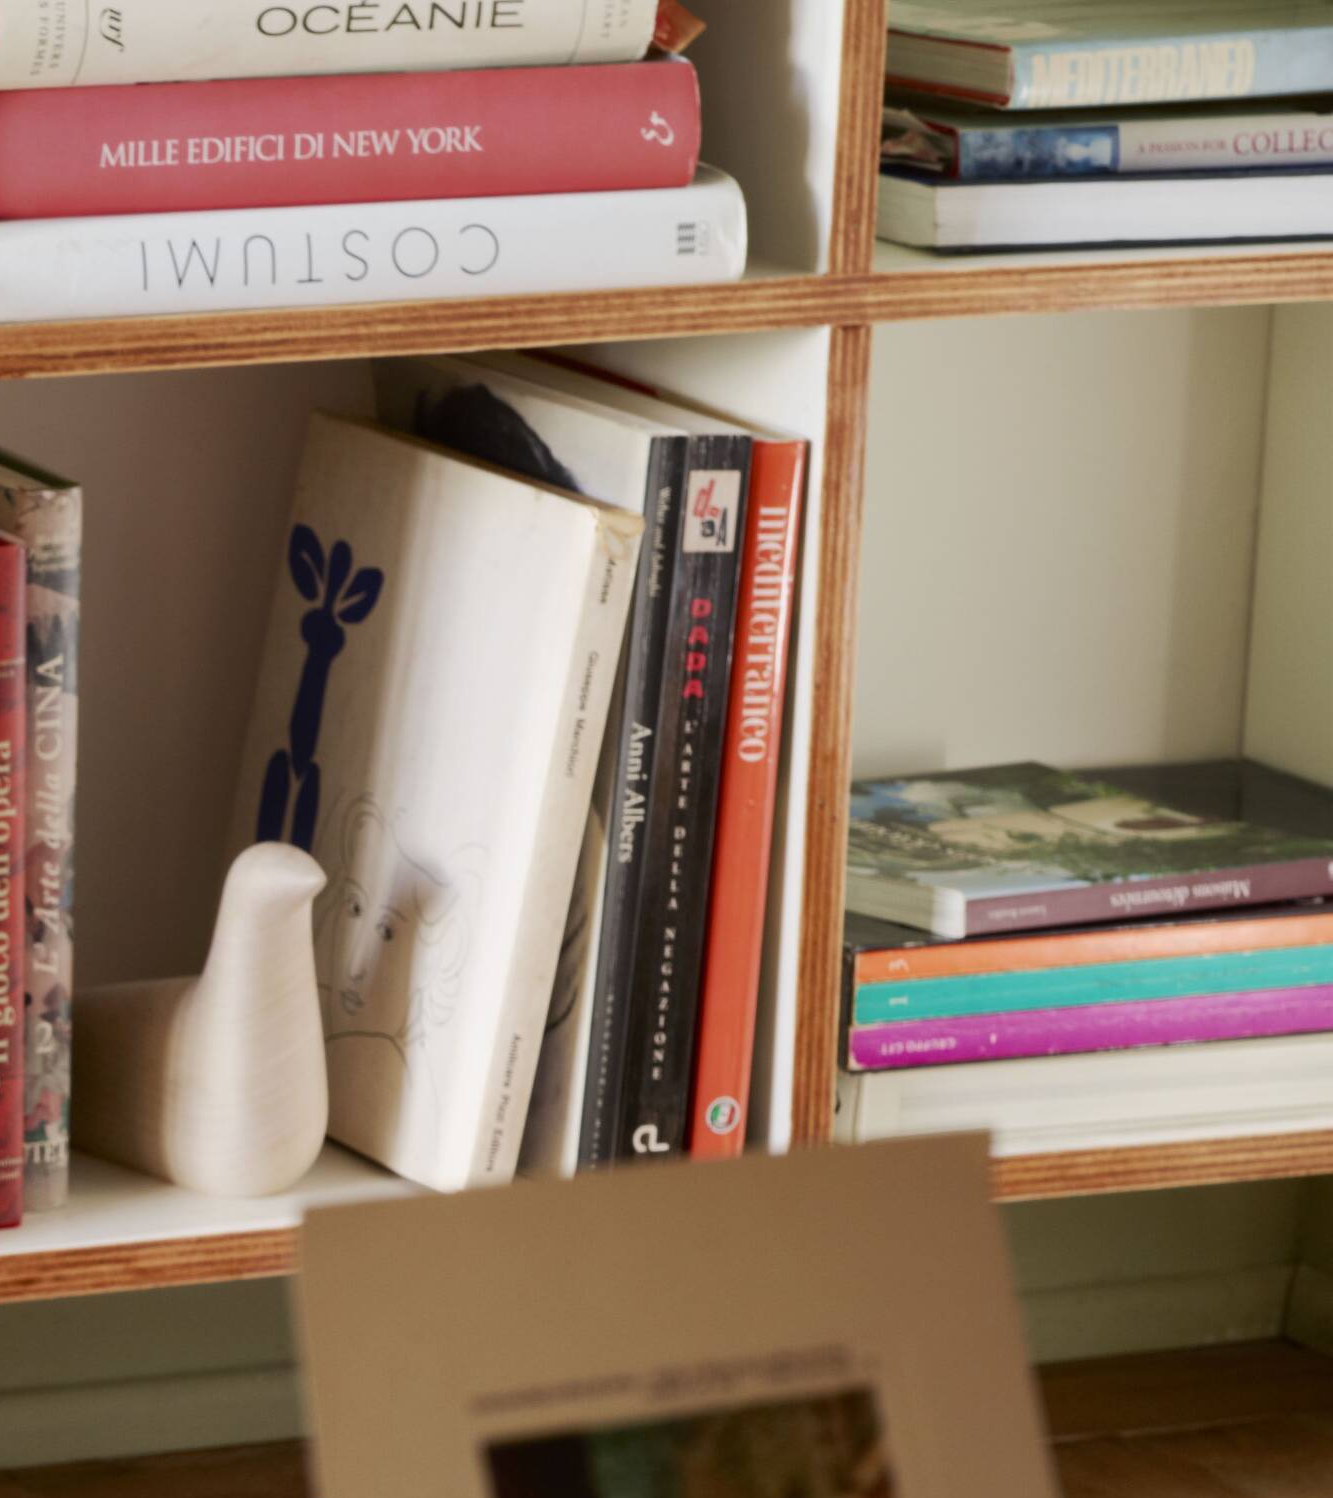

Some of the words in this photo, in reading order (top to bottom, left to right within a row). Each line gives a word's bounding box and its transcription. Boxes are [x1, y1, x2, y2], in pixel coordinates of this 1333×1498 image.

[257, 0, 525, 37] OCÉANIE
[99, 138, 179, 169] MILLE
[187, 134, 285, 165] EDIFICI
[294, 133, 324, 160] DI
[332, 128, 399, 157] NEW
[407, 125, 484, 155] YORK
[140, 224, 501, 291] COSTUMI
[682, 598, 713, 699] DADA
[738, 505, 789, 763] mediterraneo
[35, 652, 64, 762] CINA
[577, 650, 600, 712] Giuseppe
[626, 722, 653, 782] Anni
[34, 774, 64, 850] della
[613, 787, 646, 864] Albers
[666, 826, 688, 911] DELLA
[1191, 878, 1251, 899] Maisons
[651, 926, 677, 1081] NEGAZIONE
